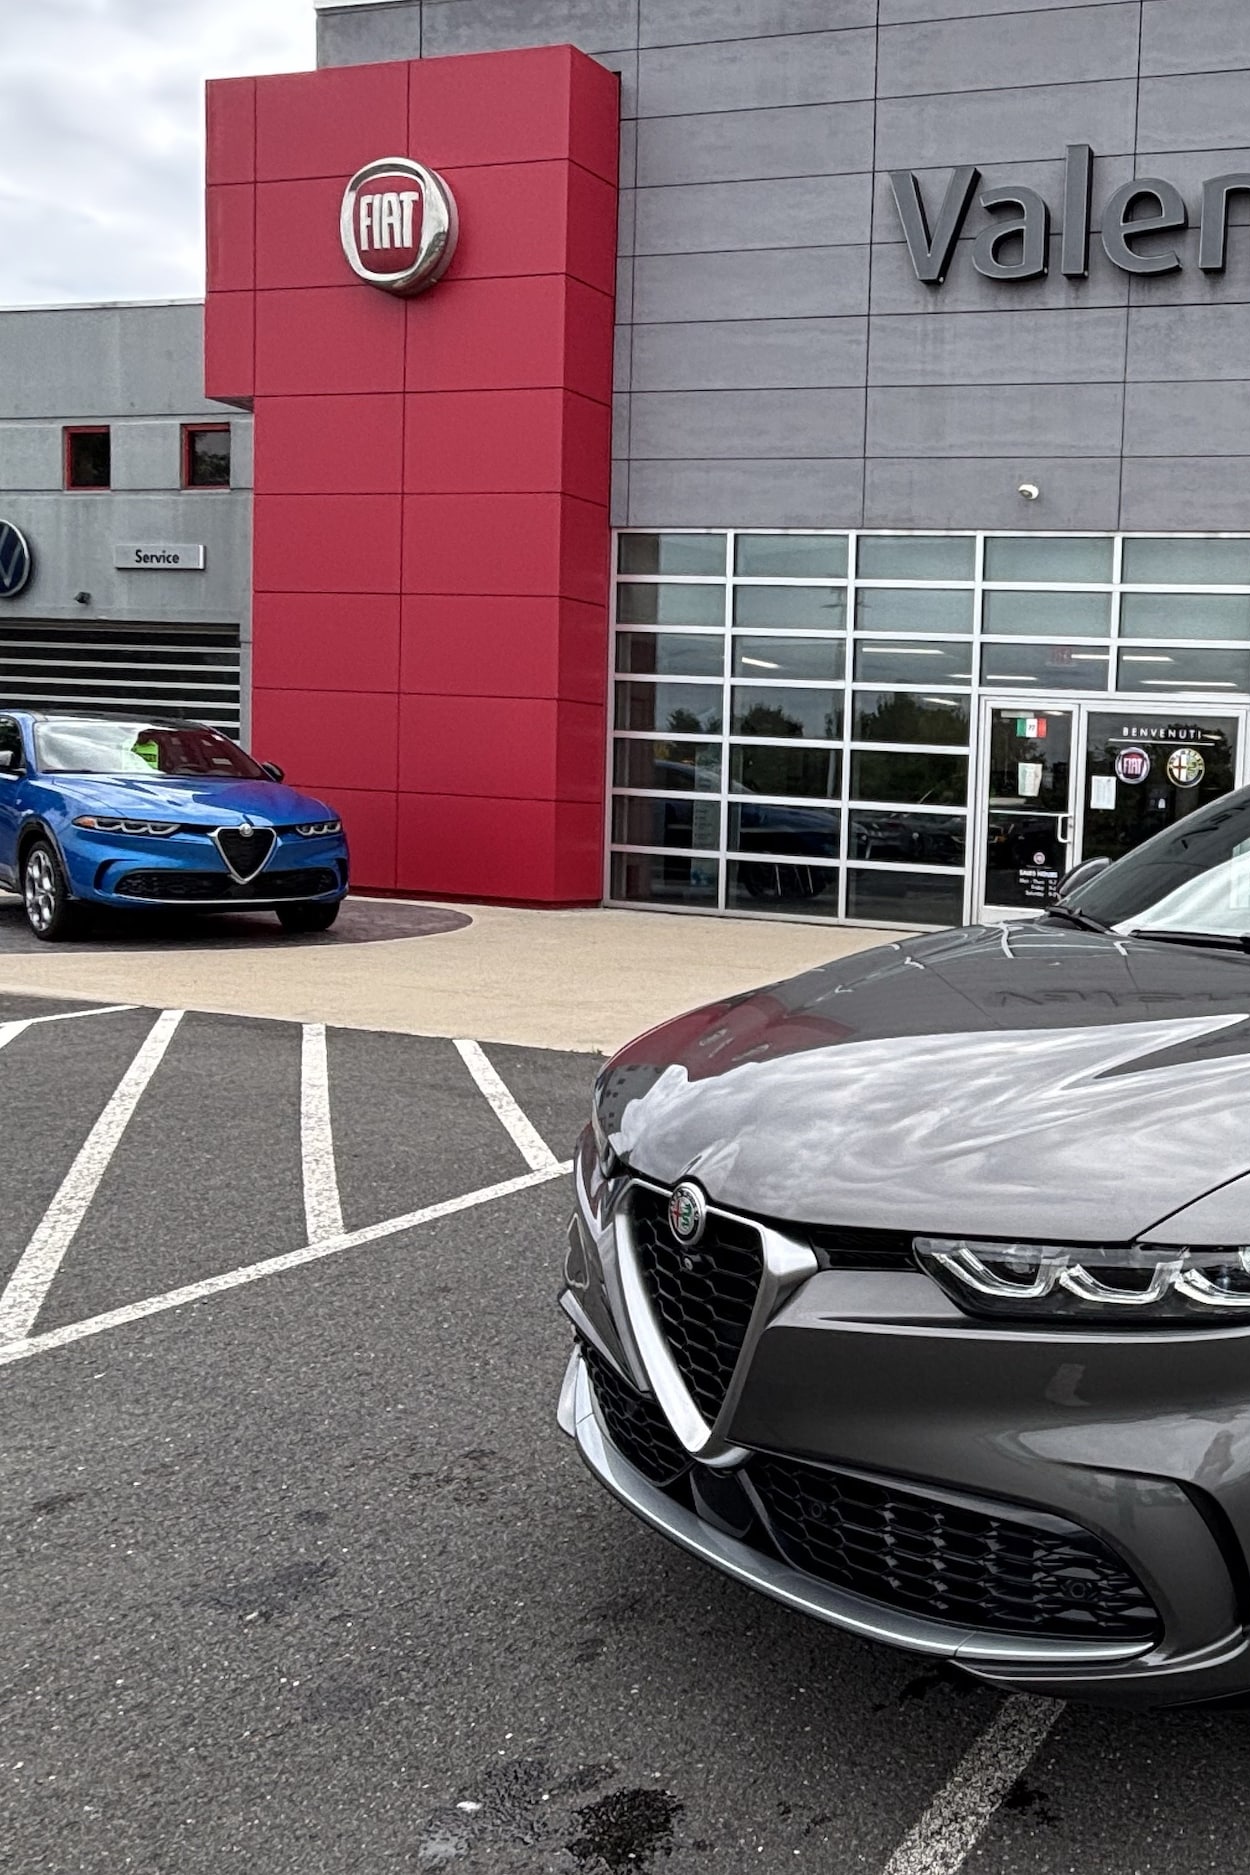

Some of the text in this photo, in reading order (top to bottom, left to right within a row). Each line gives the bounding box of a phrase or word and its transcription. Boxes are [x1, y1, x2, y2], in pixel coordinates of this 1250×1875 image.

[360, 190, 420, 251] FIAT
[134, 548, 180, 564] Service
[1122, 726, 1202, 740] BENVENUTI
[1123, 757, 1143, 776] FIAT
